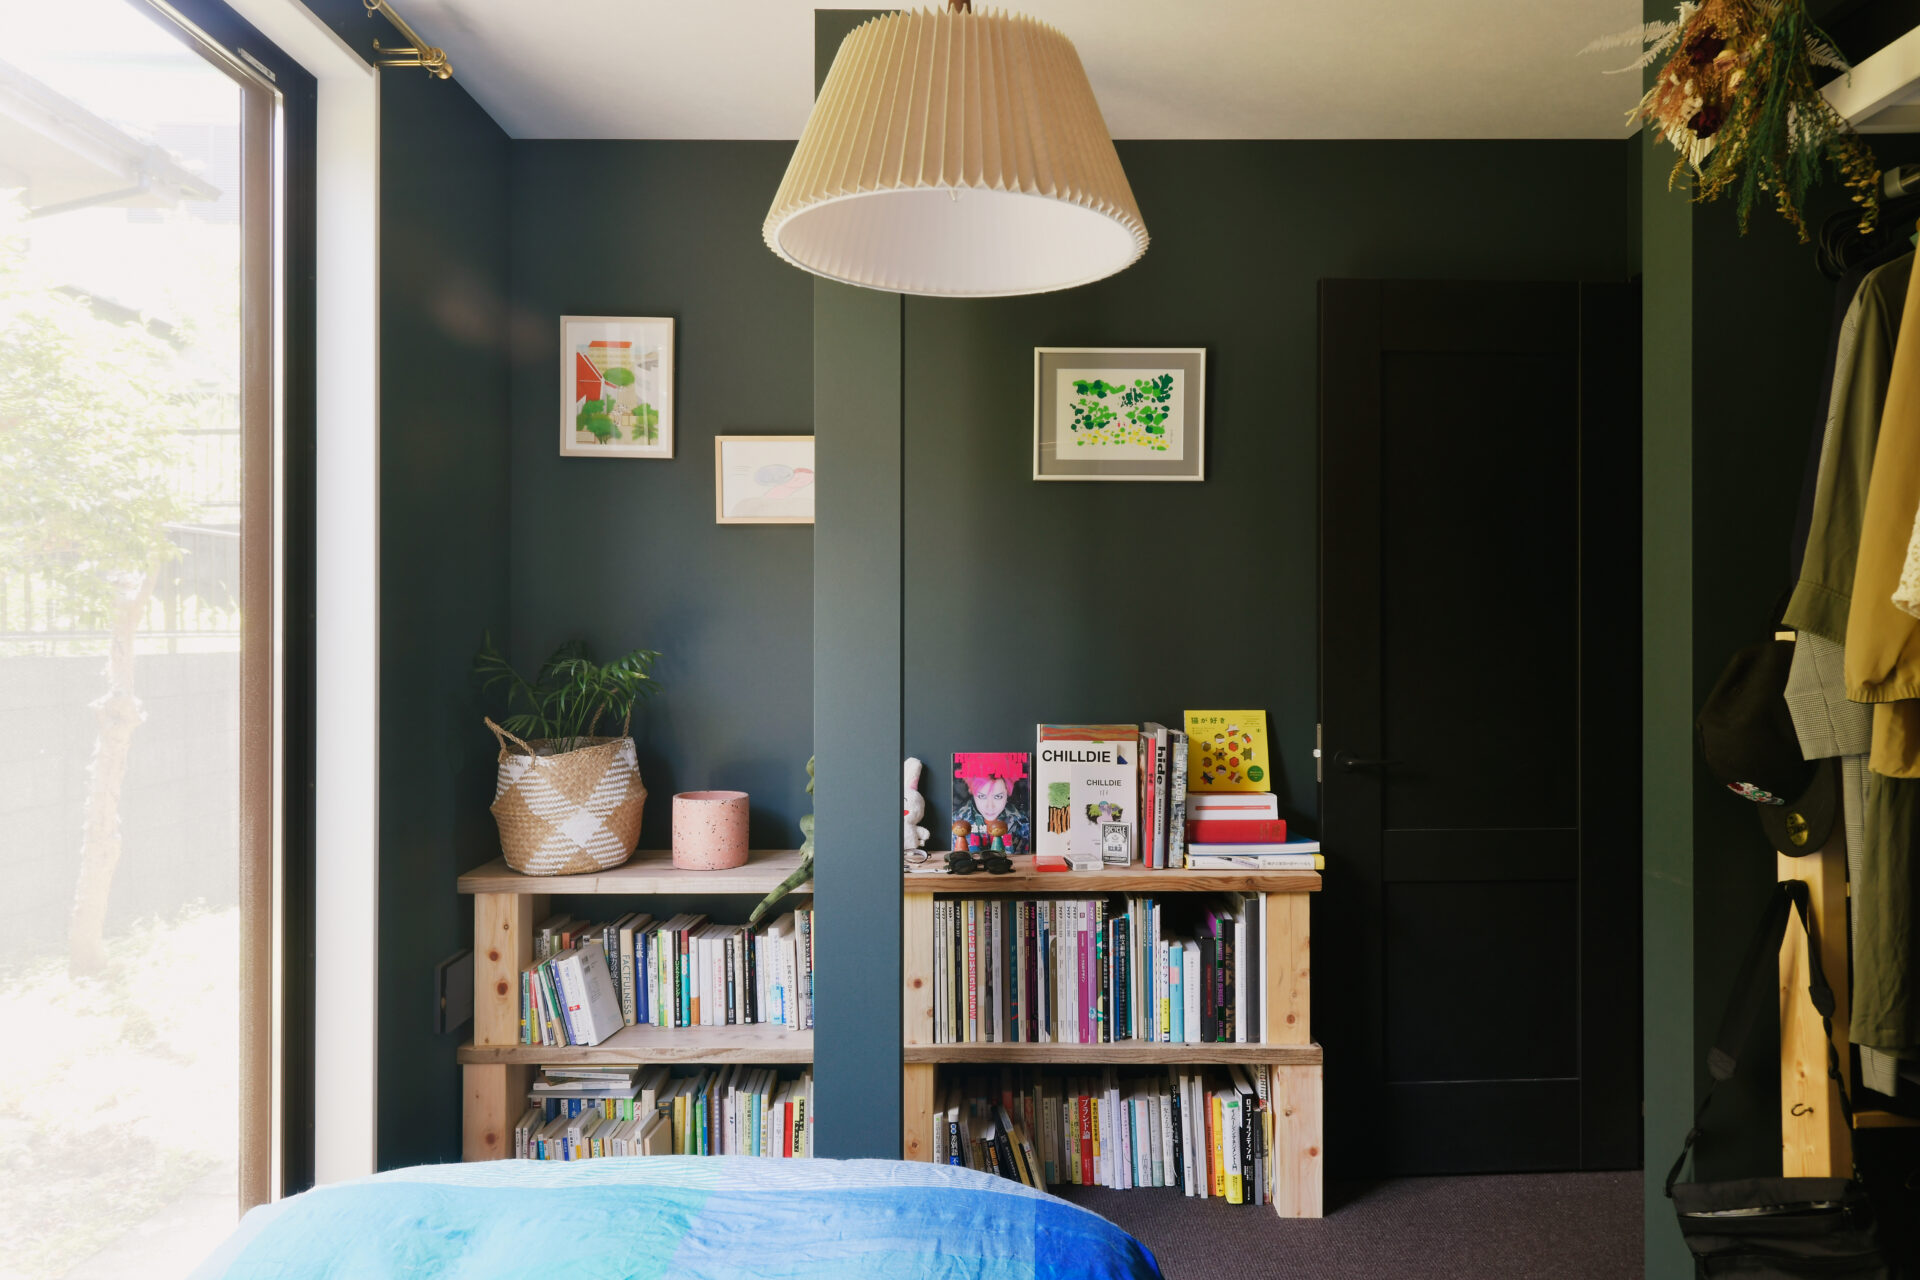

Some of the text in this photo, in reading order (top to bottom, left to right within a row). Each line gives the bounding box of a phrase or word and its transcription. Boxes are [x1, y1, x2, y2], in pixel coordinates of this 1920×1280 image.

[1042, 750, 1111, 763] CHILLDIE
[1157, 746, 1166, 785] hide
[1086, 779, 1122, 787] CHILLDIE
[1104, 825, 1128, 838] BICYCLE
[622, 954, 632, 1015] FACTFULNESS
[1081, 1098, 1091, 1140] ブランド論
